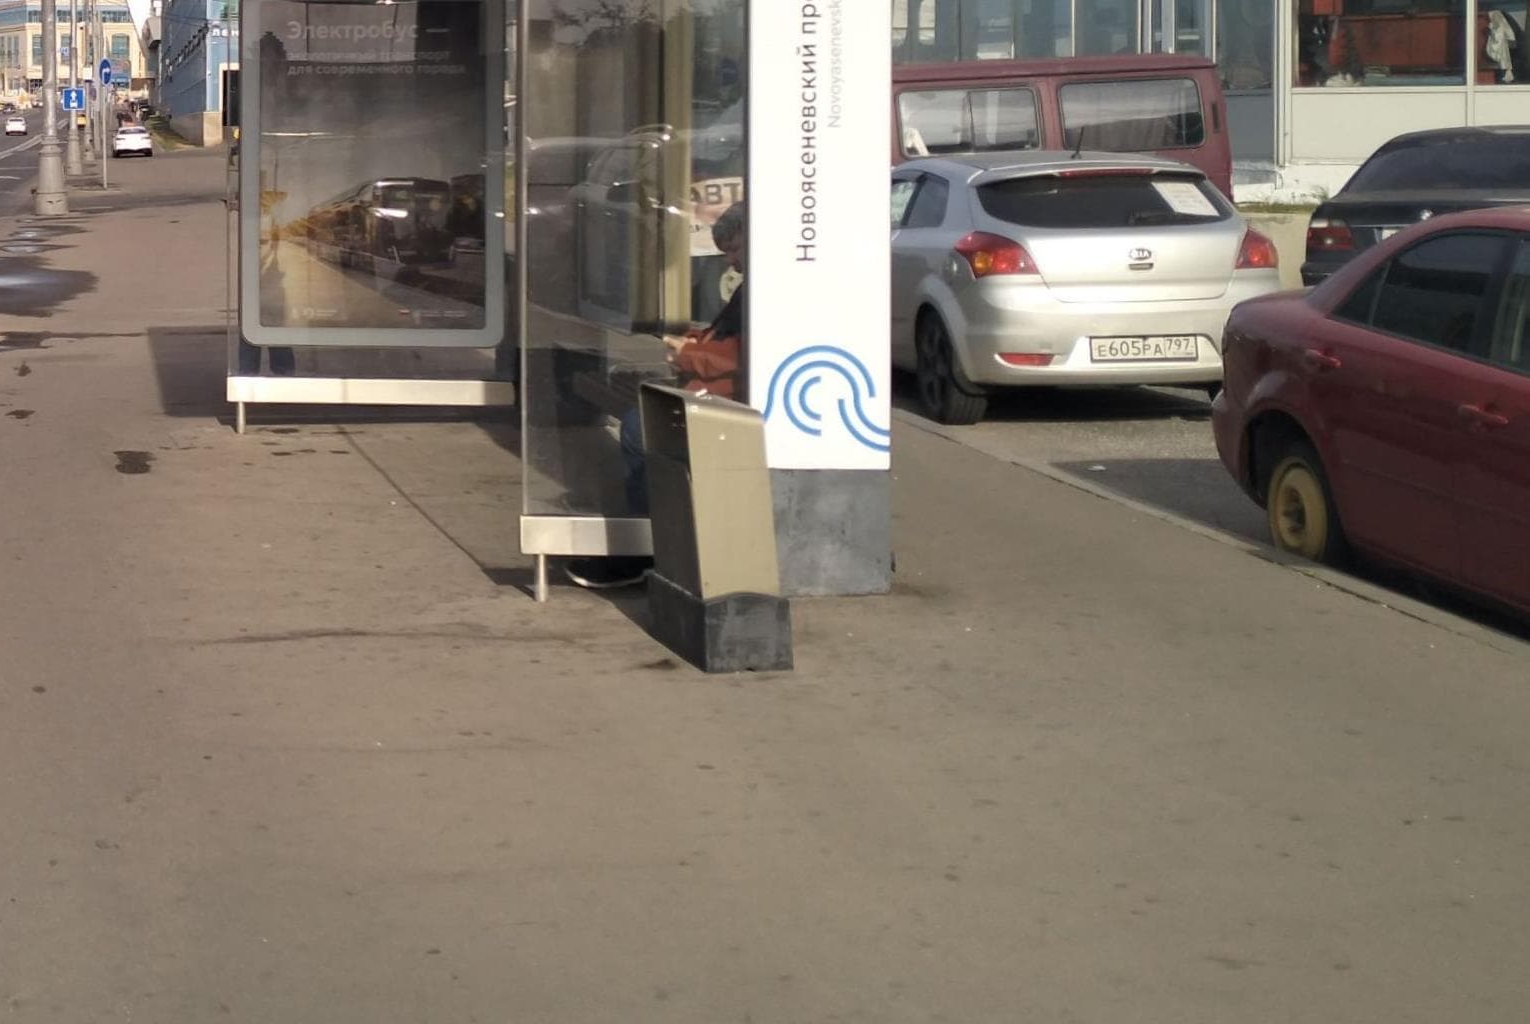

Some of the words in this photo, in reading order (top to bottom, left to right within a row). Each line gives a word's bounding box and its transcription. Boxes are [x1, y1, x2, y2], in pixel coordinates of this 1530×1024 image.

[287, 21, 418, 43] Электробус
[287, 65, 313, 76] для
[316, 65, 414, 77] современного
[796, 44, 817, 262] Новоясеневский
[1166, 338, 1190, 351] 797
